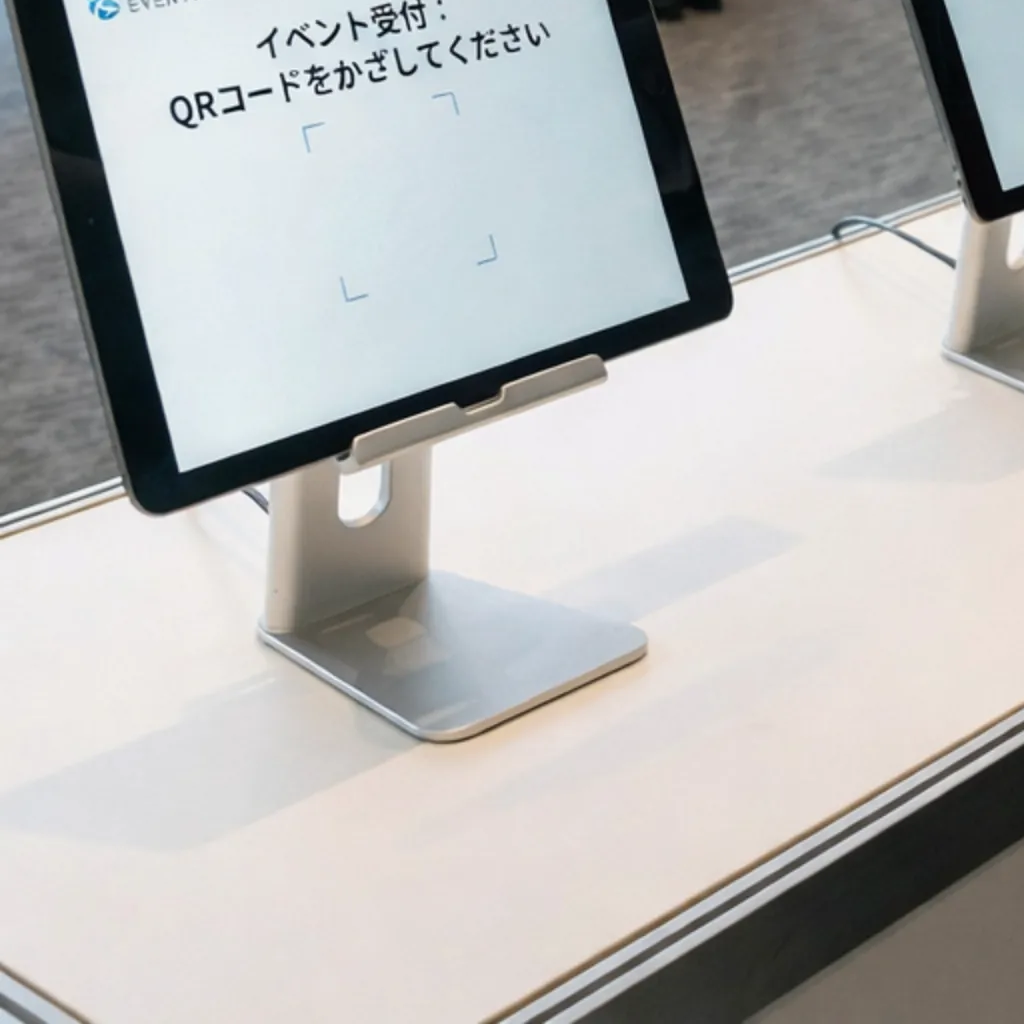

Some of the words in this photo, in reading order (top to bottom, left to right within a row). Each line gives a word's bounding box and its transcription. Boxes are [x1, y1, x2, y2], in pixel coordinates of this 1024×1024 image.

[169, 21, 551, 129] QRコードをかざしてください
